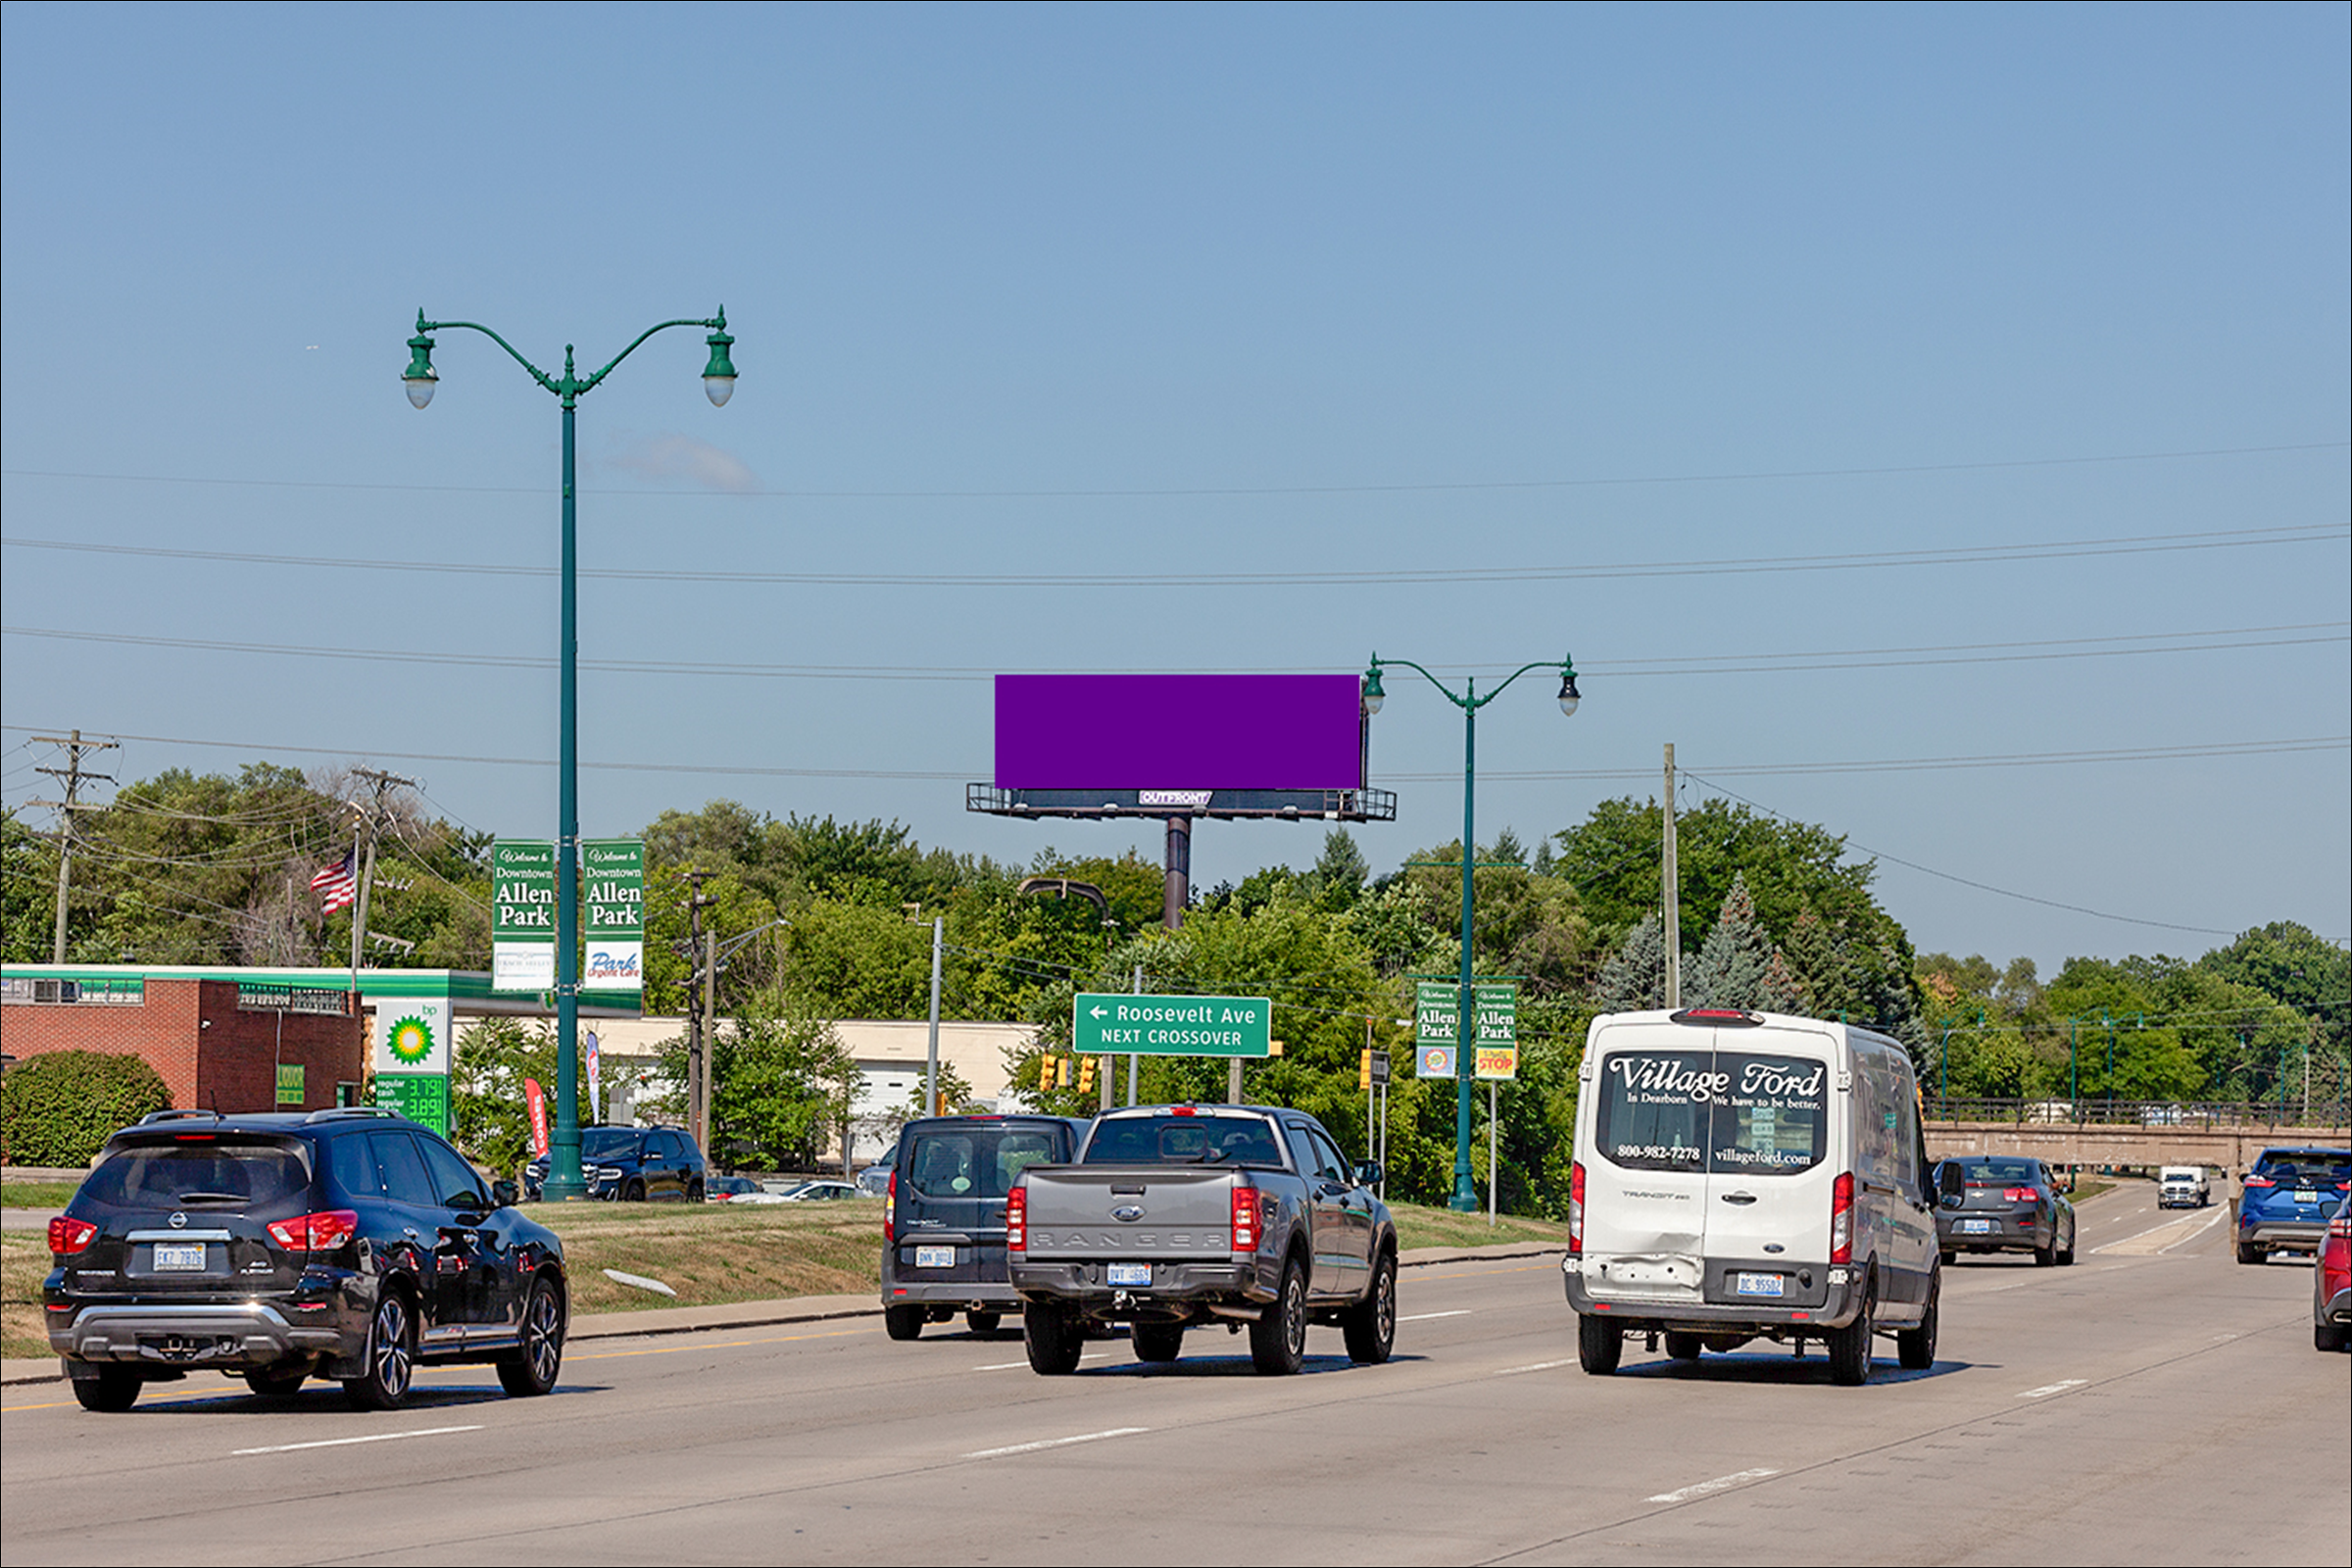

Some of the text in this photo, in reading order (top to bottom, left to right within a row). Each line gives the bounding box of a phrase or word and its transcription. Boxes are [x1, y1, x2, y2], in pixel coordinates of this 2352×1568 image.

[1141, 791, 1210, 804] OUTFRONT
[500, 849, 549, 862] Welcome to
[588, 849, 637, 862] Welcome to
[496, 867, 553, 878] Downtown
[586, 867, 642, 878] Downtown
[495, 883, 553, 904] Allen
[587, 882, 642, 904] Allen
[499, 906, 551, 926] Park
[591, 905, 639, 926] Park
[592, 952, 637, 970] Park
[587, 968, 640, 979] Urgent Care
[422, 1004, 437, 1017] bp
[1117, 1005, 1255, 1024] Roosevelt Ave
[1419, 1010, 1456, 1024] Allen
[1478, 1011, 1514, 1025] Allen
[1102, 1029, 1242, 1046] NEXT CROSSOVER
[1421, 1024, 1454, 1039] Park
[1480, 1025, 1512, 1039] Park
[1479, 1058, 1513, 1069] STOP
[377, 1079, 405, 1089] regular
[1609, 1057, 1824, 1102] Village Ford
[376, 1099, 405, 1108] regular
[1627, 1093, 1688, 1104] In Dearborn
[1713, 1096, 1822, 1110] We have to be better.
[1617, 1145, 1700, 1160] 800-982-7278
[1715, 1149, 1811, 1165] villageford.com
[1033, 1232, 1225, 1247] RANGER
